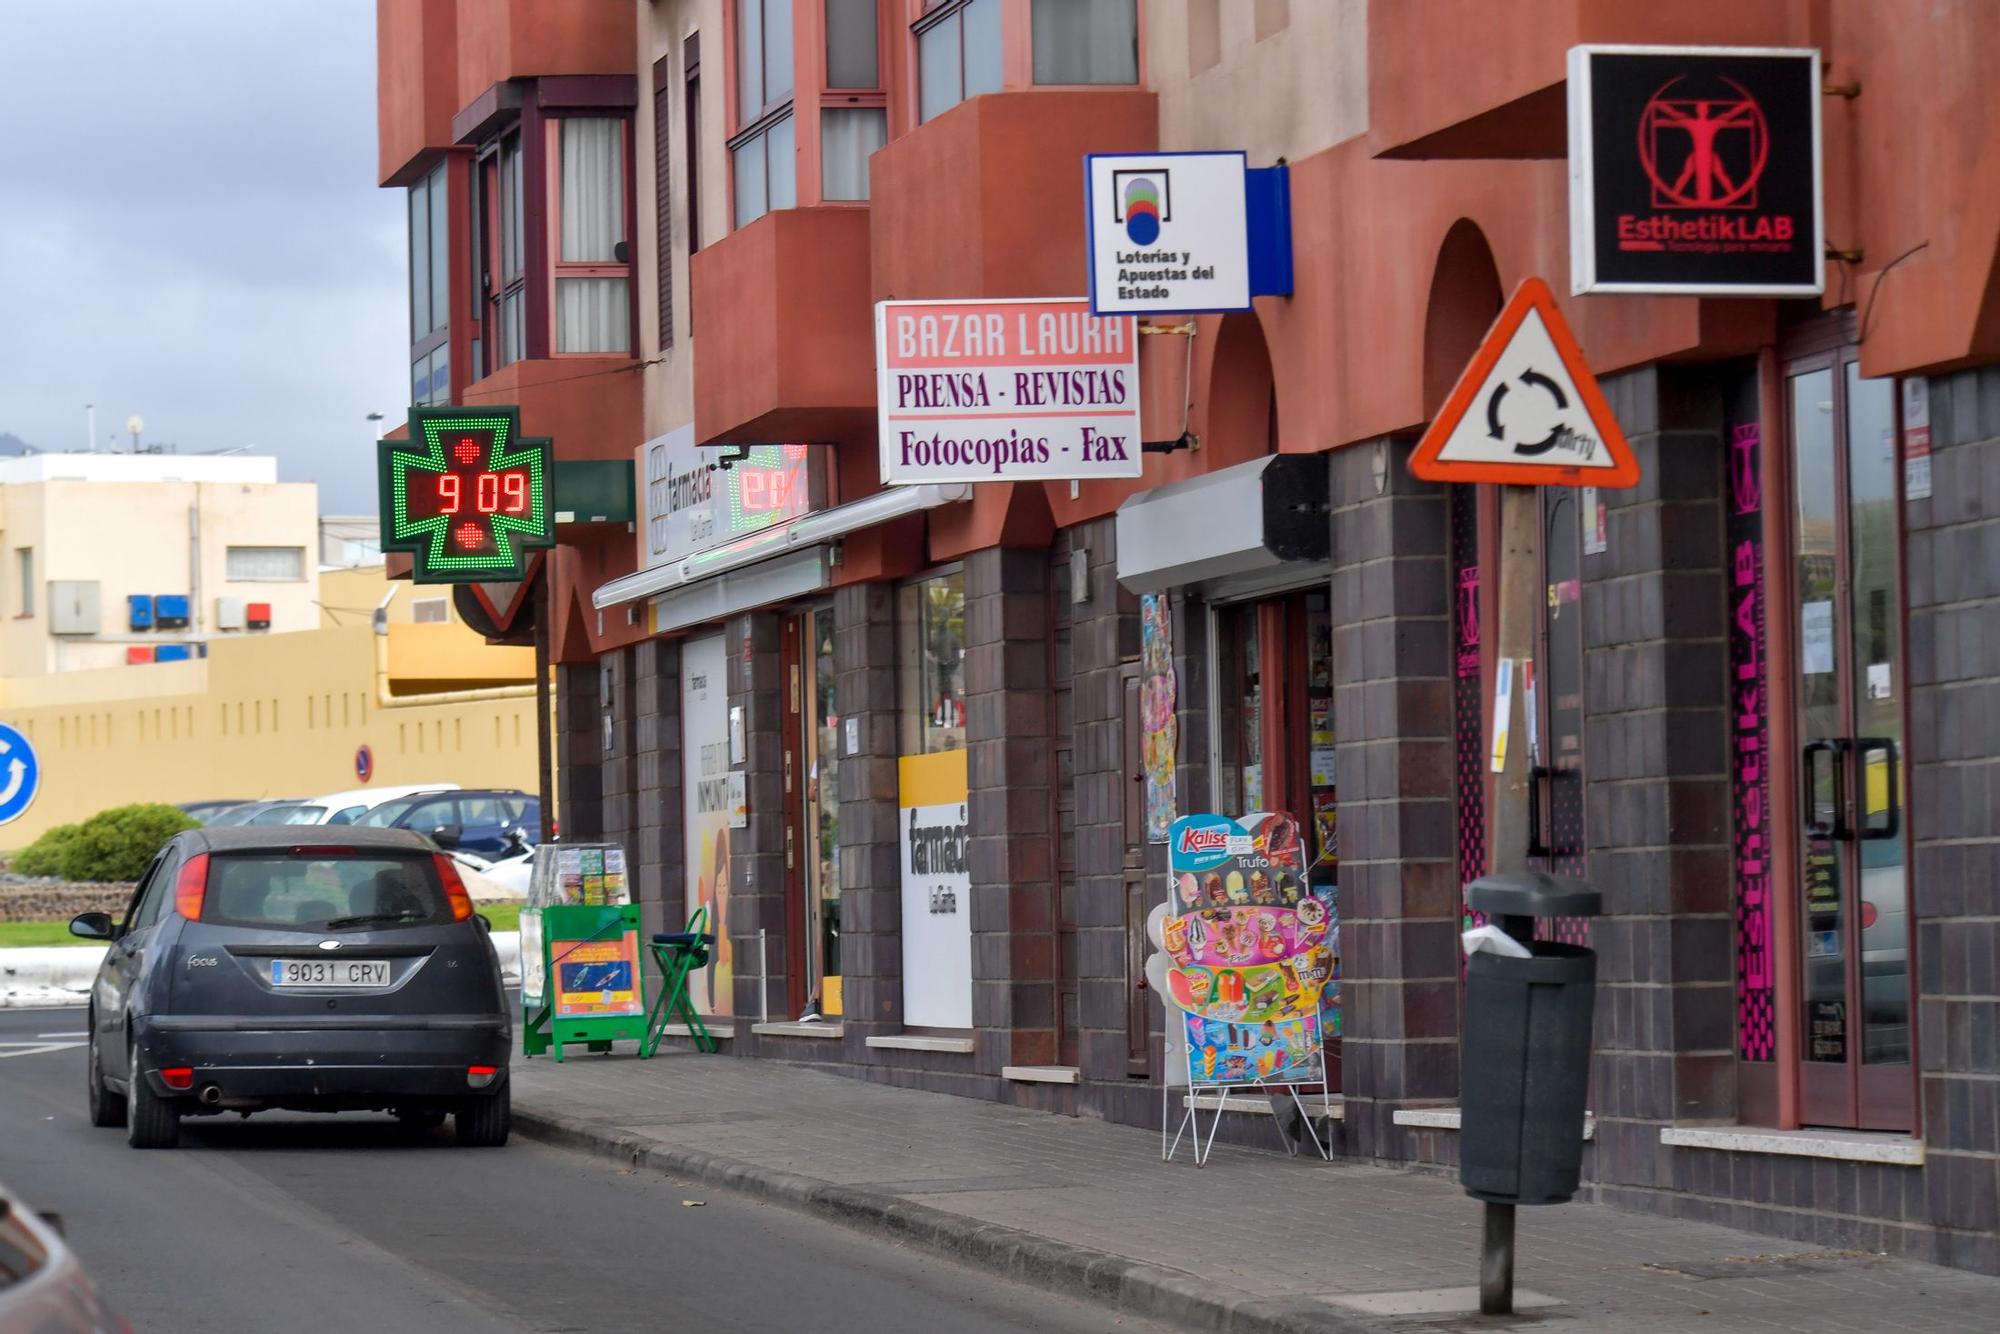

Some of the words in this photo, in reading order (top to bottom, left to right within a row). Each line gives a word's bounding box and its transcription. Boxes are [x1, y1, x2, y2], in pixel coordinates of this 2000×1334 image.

[1617, 214, 1794, 240] EsthetikLAB
[1116, 249, 1177, 264] Loterías
[1182, 251, 1190, 265] y
[1118, 268, 1187, 284] Apuestas
[1192, 266, 1214, 280] del
[1118, 285, 1169, 299] Estado
[897, 313, 1005, 358] BAZAR
[1019, 311, 1124, 355] LAURA
[898, 371, 990, 408] PRENSA
[1014, 369, 1126, 406] REVISTAS
[900, 428, 1049, 474] Fotocopias
[1081, 426, 1128, 461] Fax
[1735, 540, 1764, 990] EsthetikLAB
[1183, 826, 1229, 853] Kalise
[1236, 856, 1269, 868] Trufo
[288, 963, 336, 983] 9031
[349, 964, 387, 982] CRV
